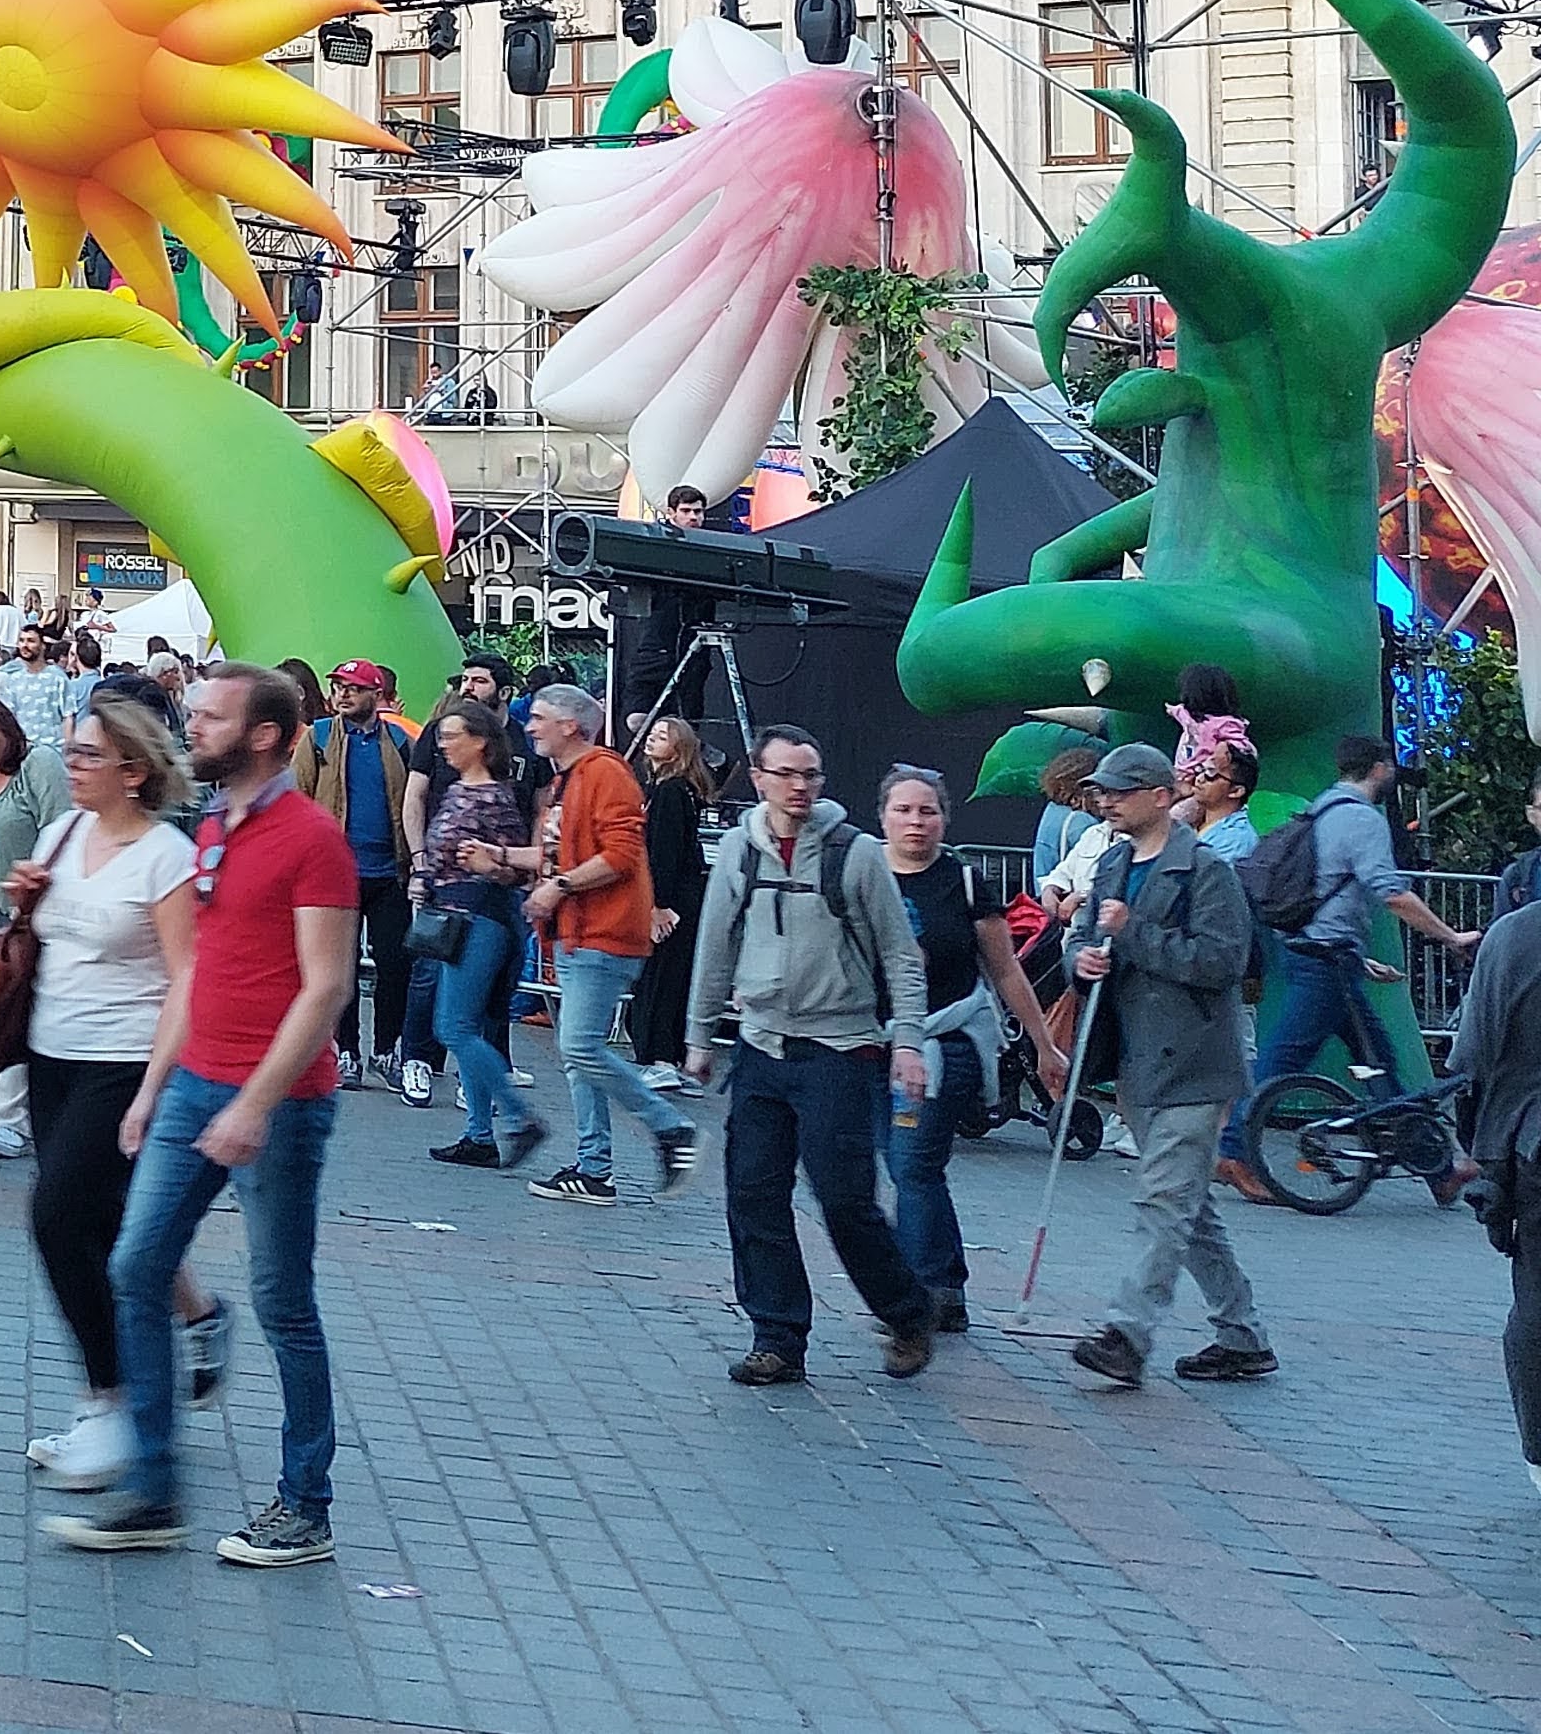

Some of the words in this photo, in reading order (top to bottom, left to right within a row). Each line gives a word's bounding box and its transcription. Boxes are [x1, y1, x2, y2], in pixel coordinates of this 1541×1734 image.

[105, 554, 164, 571] ROSSEL
[105, 571, 126, 584] LA
[129, 571, 163, 586] VOIX
